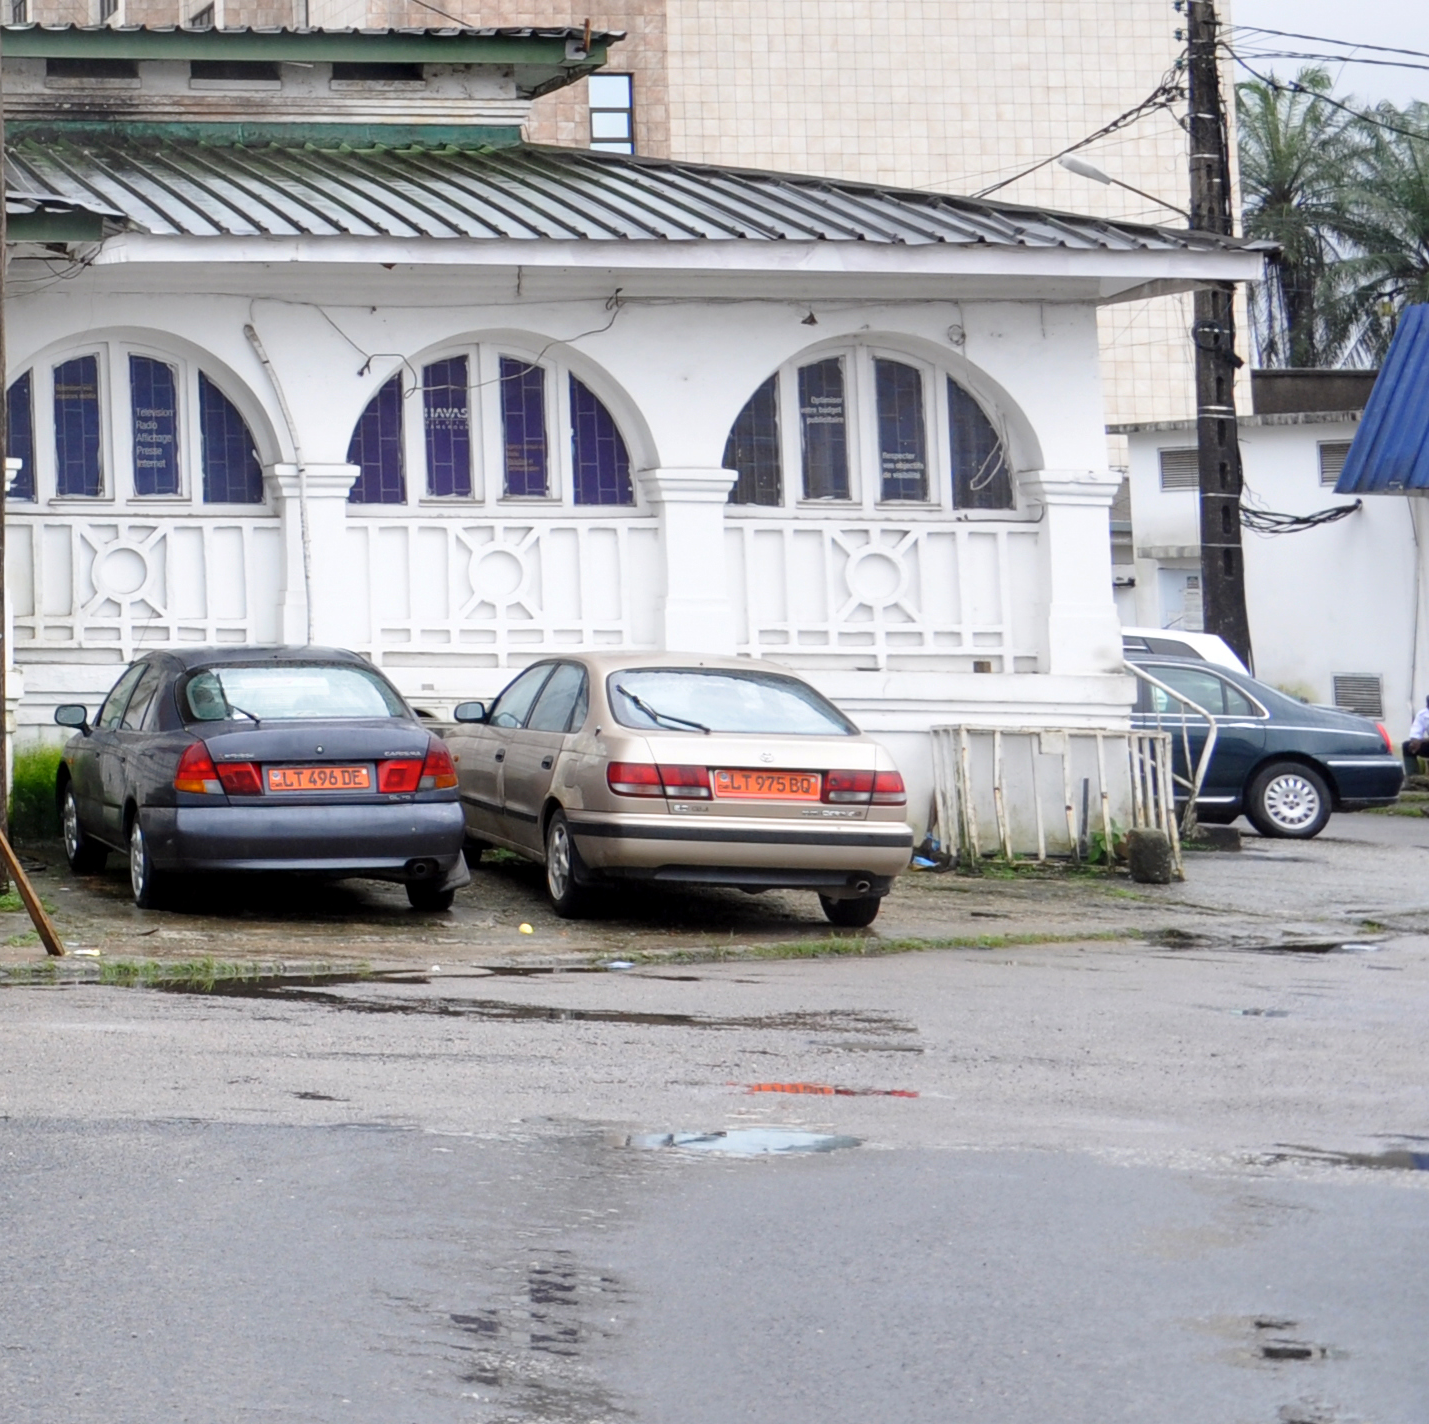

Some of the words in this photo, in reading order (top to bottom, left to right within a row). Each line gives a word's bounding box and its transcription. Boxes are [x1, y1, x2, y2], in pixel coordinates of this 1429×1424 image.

[424, 407, 468, 418] HAVAS
[136, 420, 158, 430] Radio
[136, 445, 163, 456] Presse
[137, 459, 167, 468] Internet
[283, 771, 305, 788] LT
[308, 770, 338, 787] 496
[341, 769, 364, 786] DE
[730, 774, 752, 791] LT
[755, 775, 786, 792] 975
[789, 776, 812, 793] BQ
